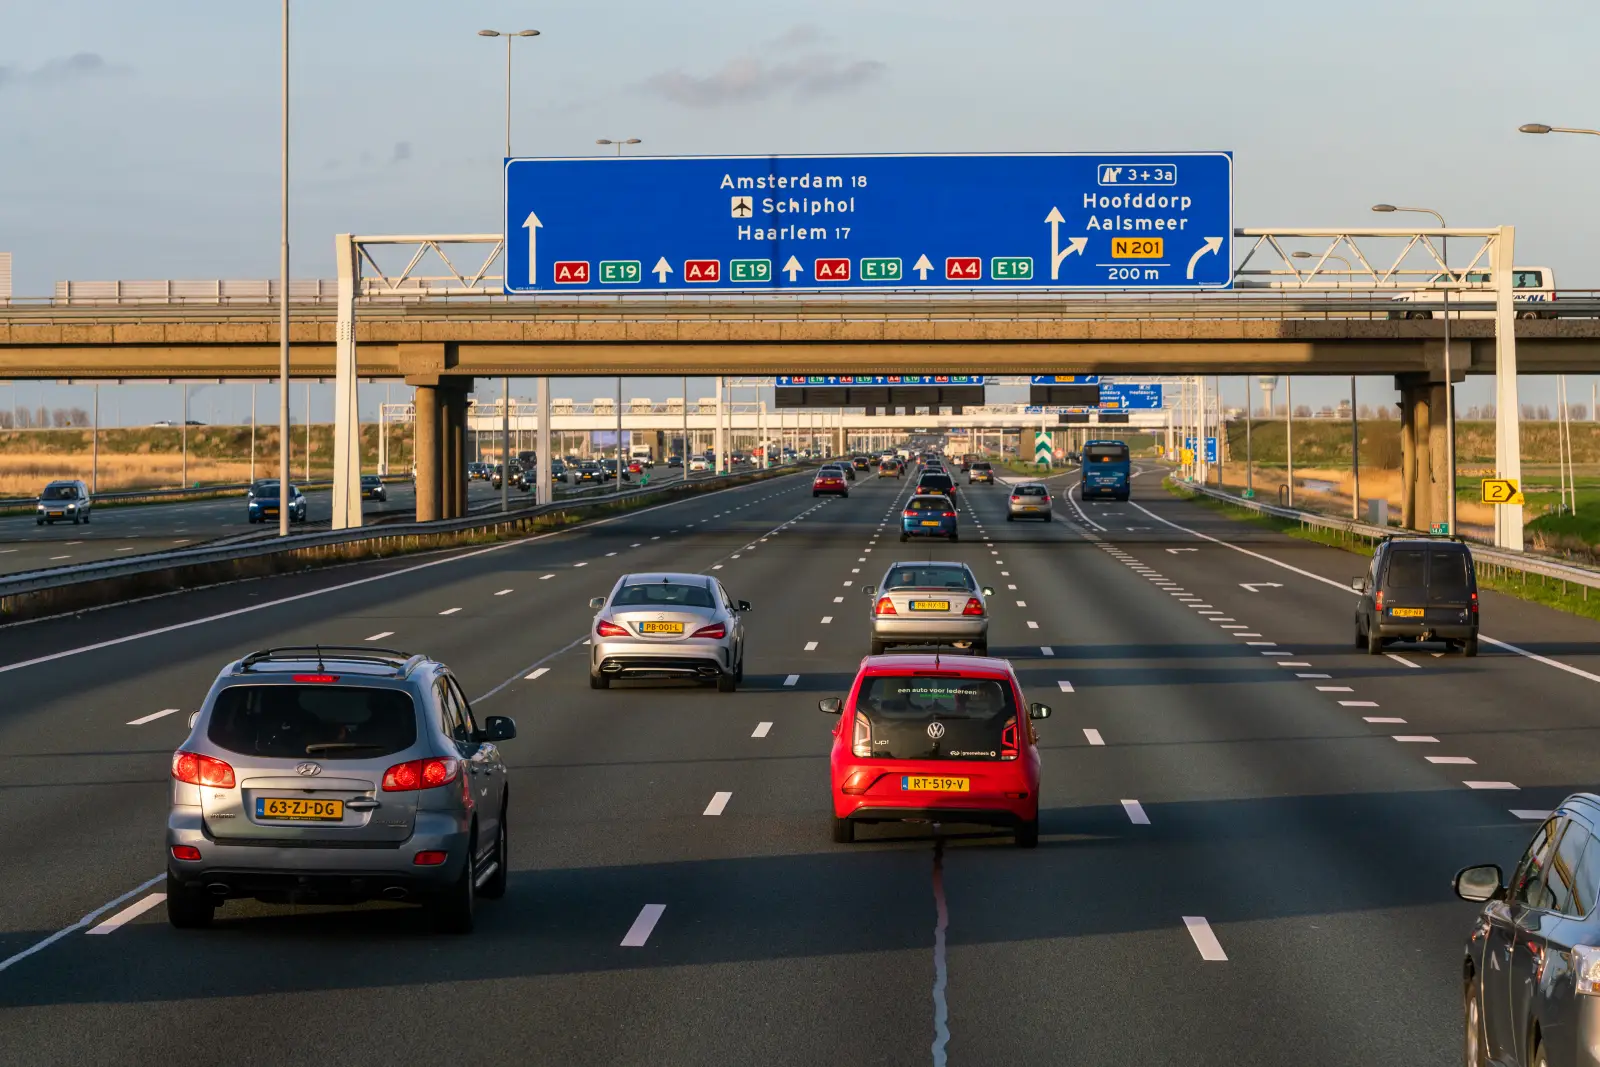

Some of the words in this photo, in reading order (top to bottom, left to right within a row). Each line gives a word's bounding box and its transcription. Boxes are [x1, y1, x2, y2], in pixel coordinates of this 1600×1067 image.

[720, 172, 843, 189] Amsterdam
[851, 175, 867, 188] 18
[762, 197, 855, 216] Schiphol
[1083, 192, 1192, 211] Hoofddorp
[1086, 215, 1188, 231] Aalsmeer
[738, 224, 827, 241] Haarlem
[835, 227, 851, 239] 17
[1108, 267, 1140, 280] 200
[1144, 269, 1159, 280] m
[1492, 485, 1503, 498] 2
[646, 623, 680, 631] PB-001-L
[913, 778, 964, 789] RT-519-V
[269, 801, 335, 815] 63-ZJ-DG
